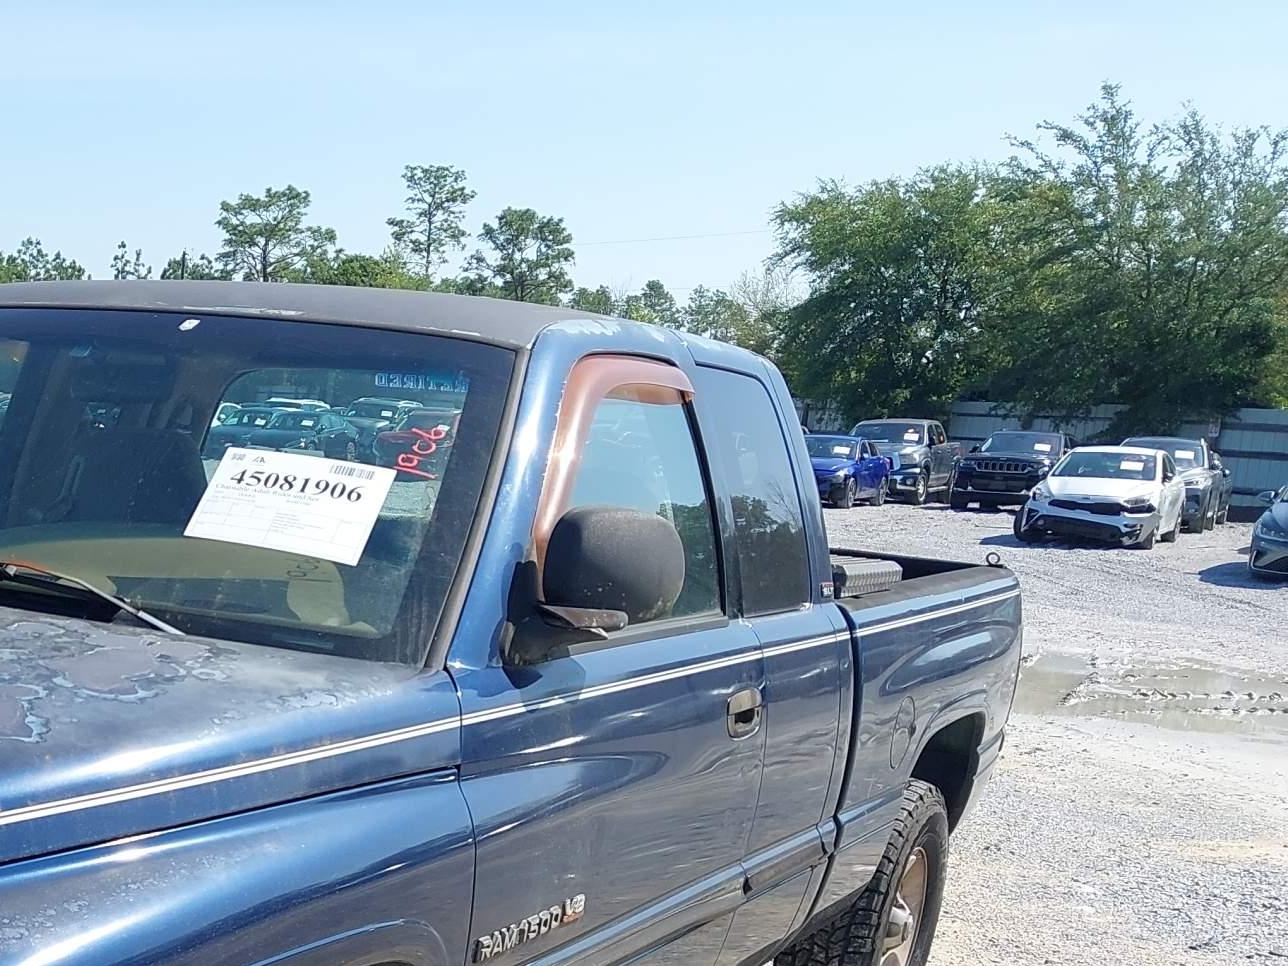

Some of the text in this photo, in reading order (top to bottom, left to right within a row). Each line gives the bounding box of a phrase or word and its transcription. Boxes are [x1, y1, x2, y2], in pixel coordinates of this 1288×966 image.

[230, 468, 364, 503] 45081906
[478, 893, 586, 961] RAM 1500 V8
